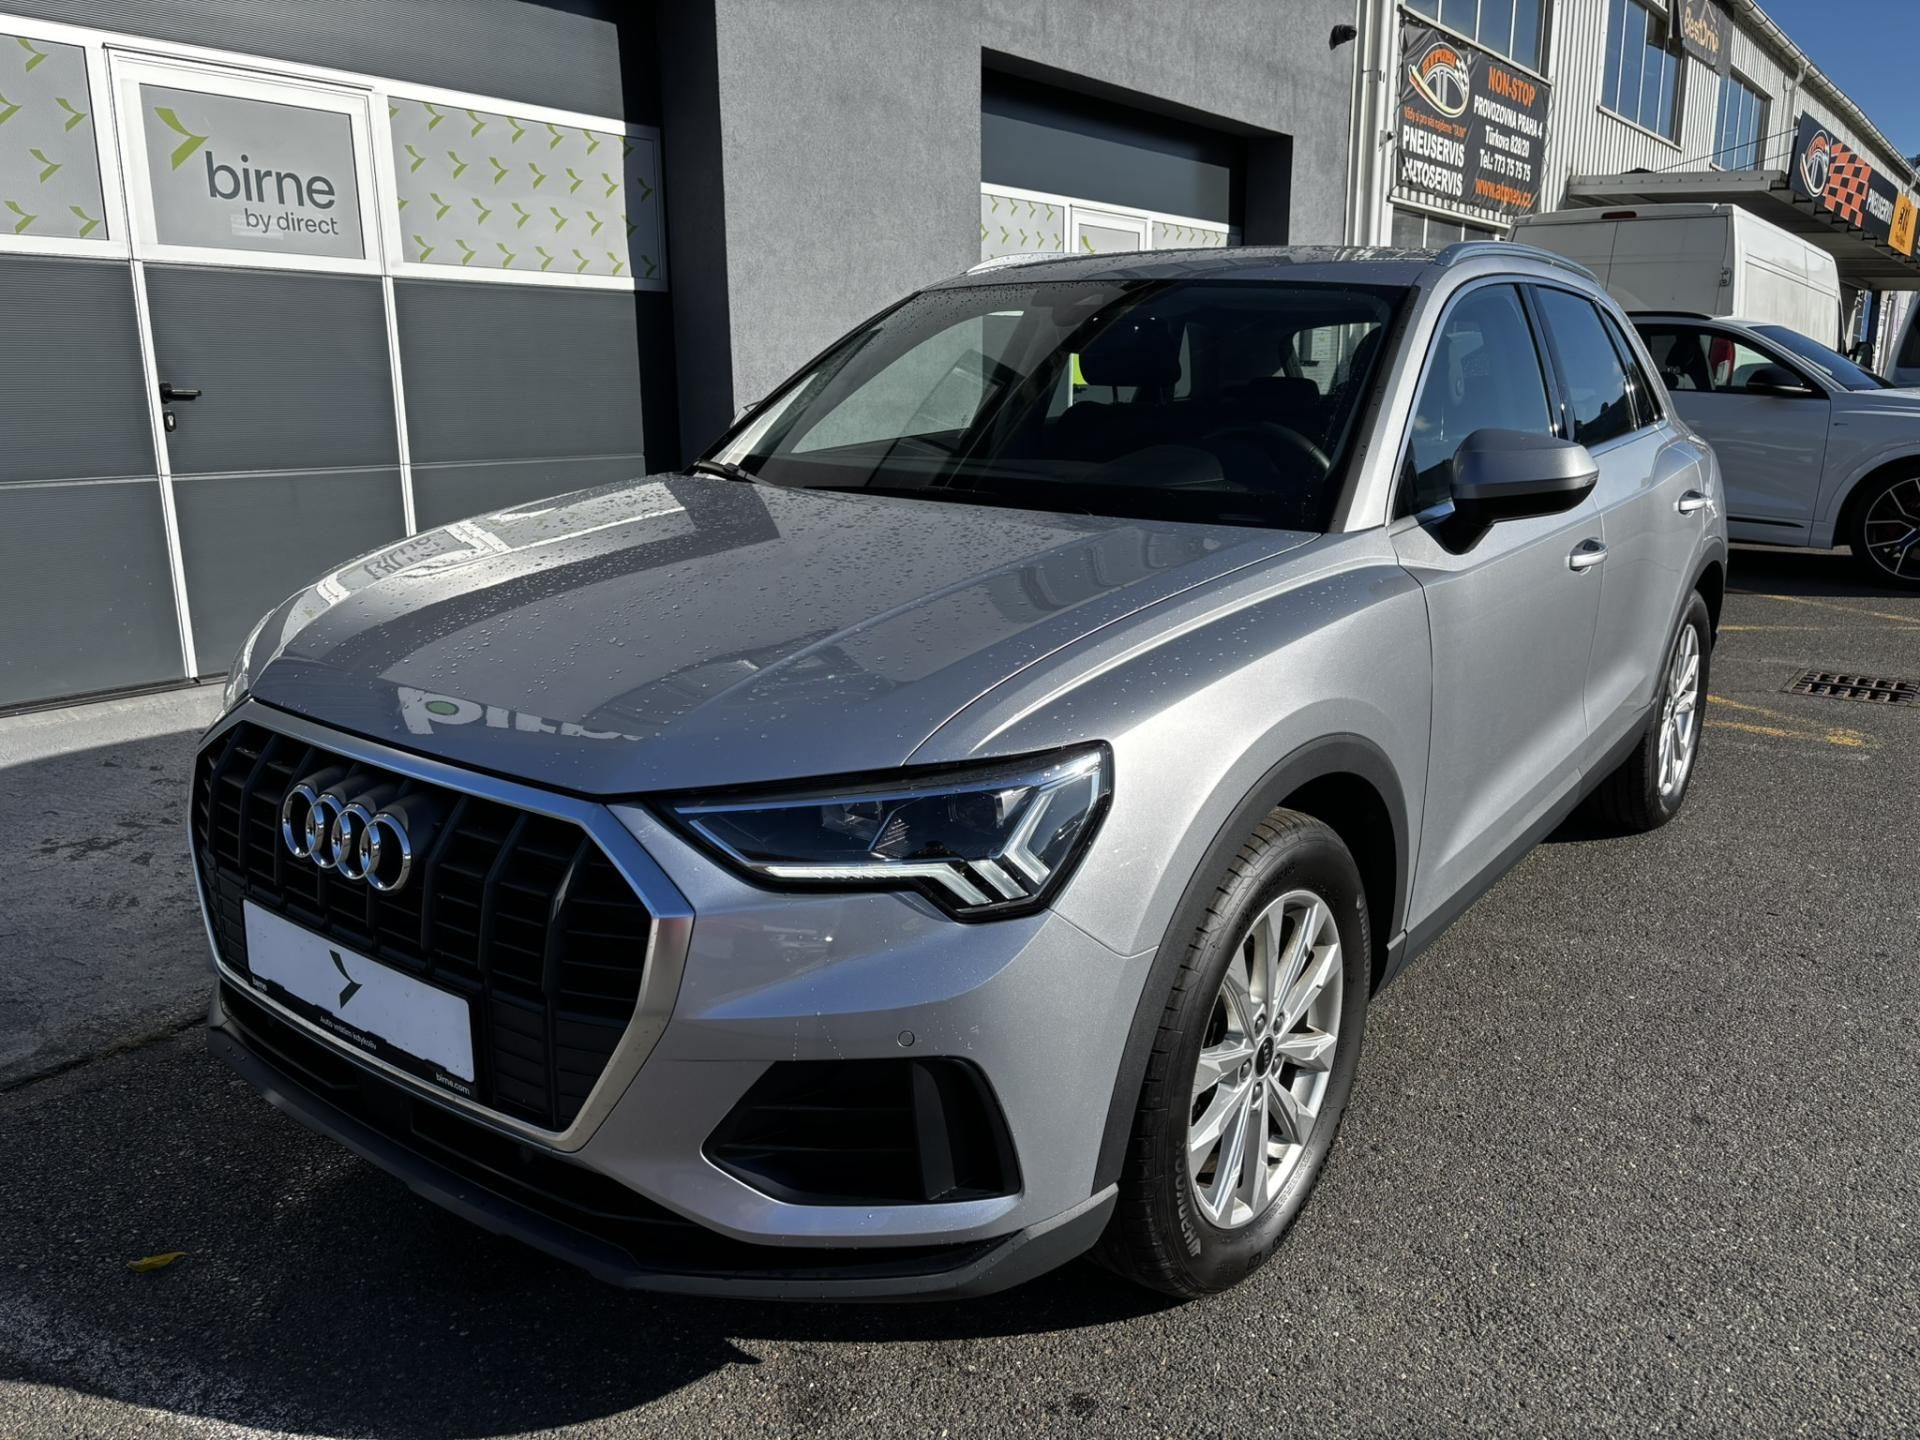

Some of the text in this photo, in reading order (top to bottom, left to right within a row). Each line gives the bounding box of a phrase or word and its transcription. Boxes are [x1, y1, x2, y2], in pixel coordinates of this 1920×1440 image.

[1487, 65, 1536, 108] NON-STOP
[1473, 94, 1517, 130] PROVOZOVNA
[1517, 113, 1537, 138] PRAHA
[1538, 122, 1543, 139] 4
[1402, 125, 1465, 168] PNEUSERVIS
[1494, 153, 1506, 174] 773
[1506, 157, 1515, 177] 75
[1515, 160, 1523, 179] 75
[1523, 163, 1531, 182] 75
[205, 150, 335, 209] birne
[1402, 156, 1463, 196] AUTOSERVIS
[244, 208, 339, 235] by direct
